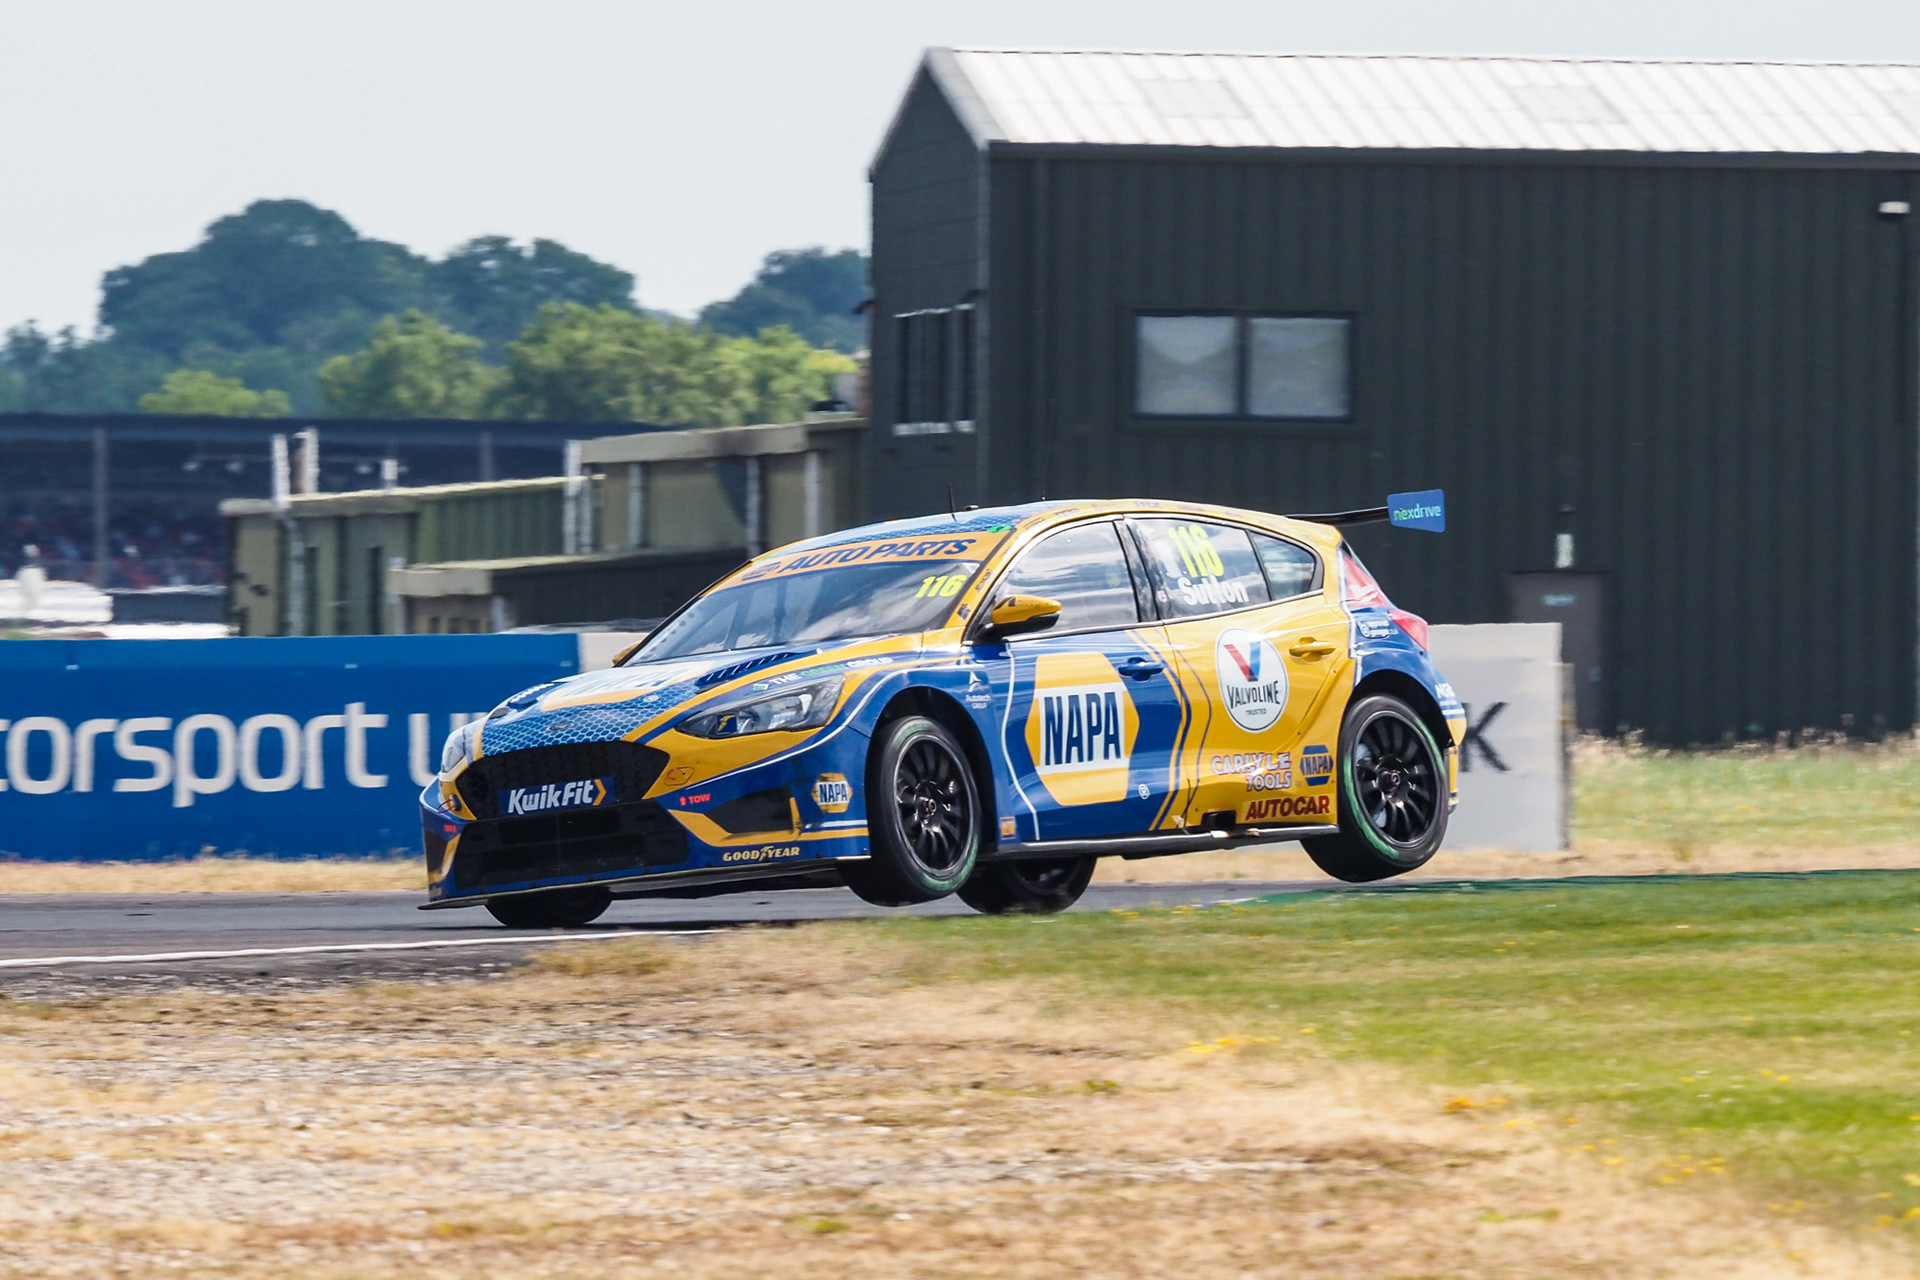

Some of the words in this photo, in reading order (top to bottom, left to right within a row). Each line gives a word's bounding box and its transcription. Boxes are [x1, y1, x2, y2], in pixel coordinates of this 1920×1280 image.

[1394, 503, 1441, 521] nexdrive
[780, 546, 864, 573] AUTO
[864, 539, 976, 560] PARTS
[1167, 524, 1224, 578] 116
[915, 574, 968, 598] 116
[1177, 575, 1249, 605] Sutton
[769, 672, 802, 685] THE
[1226, 680, 1280, 709] VALVOLINE
[1044, 691, 1121, 766] NAPA
[0, 701, 388, 808] orsport
[1211, 752, 1291, 775] CARLYLE
[1304, 754, 1330, 775] NAPA
[819, 783, 848, 803] NAPA
[1246, 771, 1292, 791] TOOLS
[688, 793, 711, 804] TOW
[1245, 795, 1330, 820] AUTOCAR
